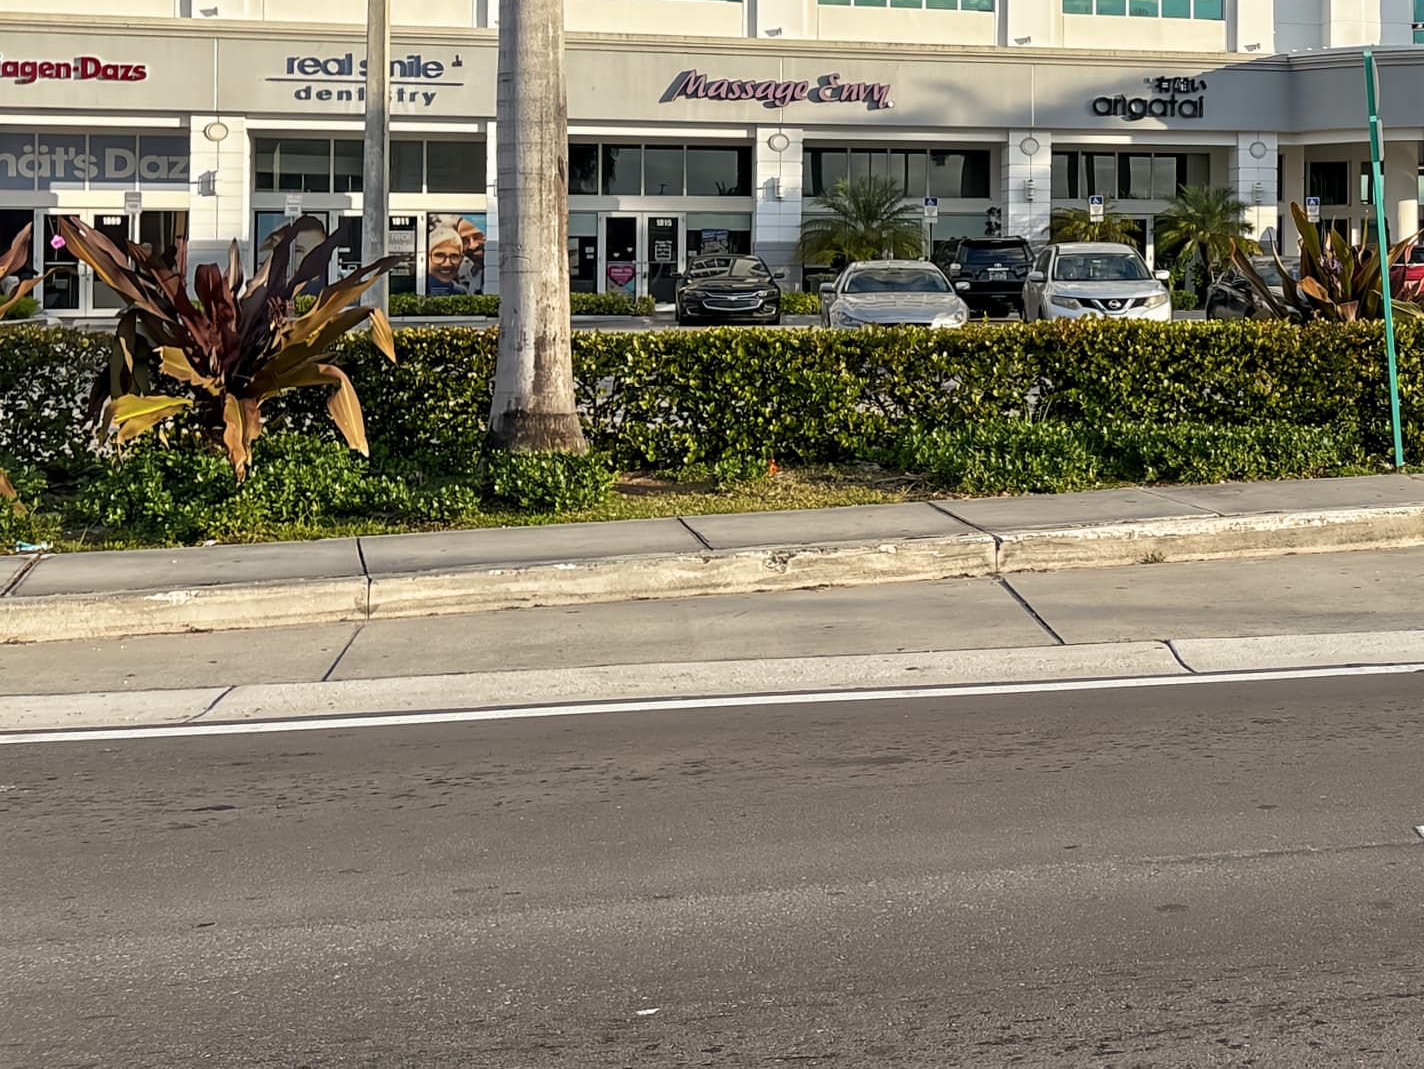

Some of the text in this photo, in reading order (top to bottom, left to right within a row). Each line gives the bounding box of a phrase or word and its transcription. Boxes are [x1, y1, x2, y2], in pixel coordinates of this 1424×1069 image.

[0, 55, 148, 85] agen-Dazs
[286, 53, 353, 76] real
[294, 85, 437, 106] denttry
[660, 69, 891, 110] Massage Envy
